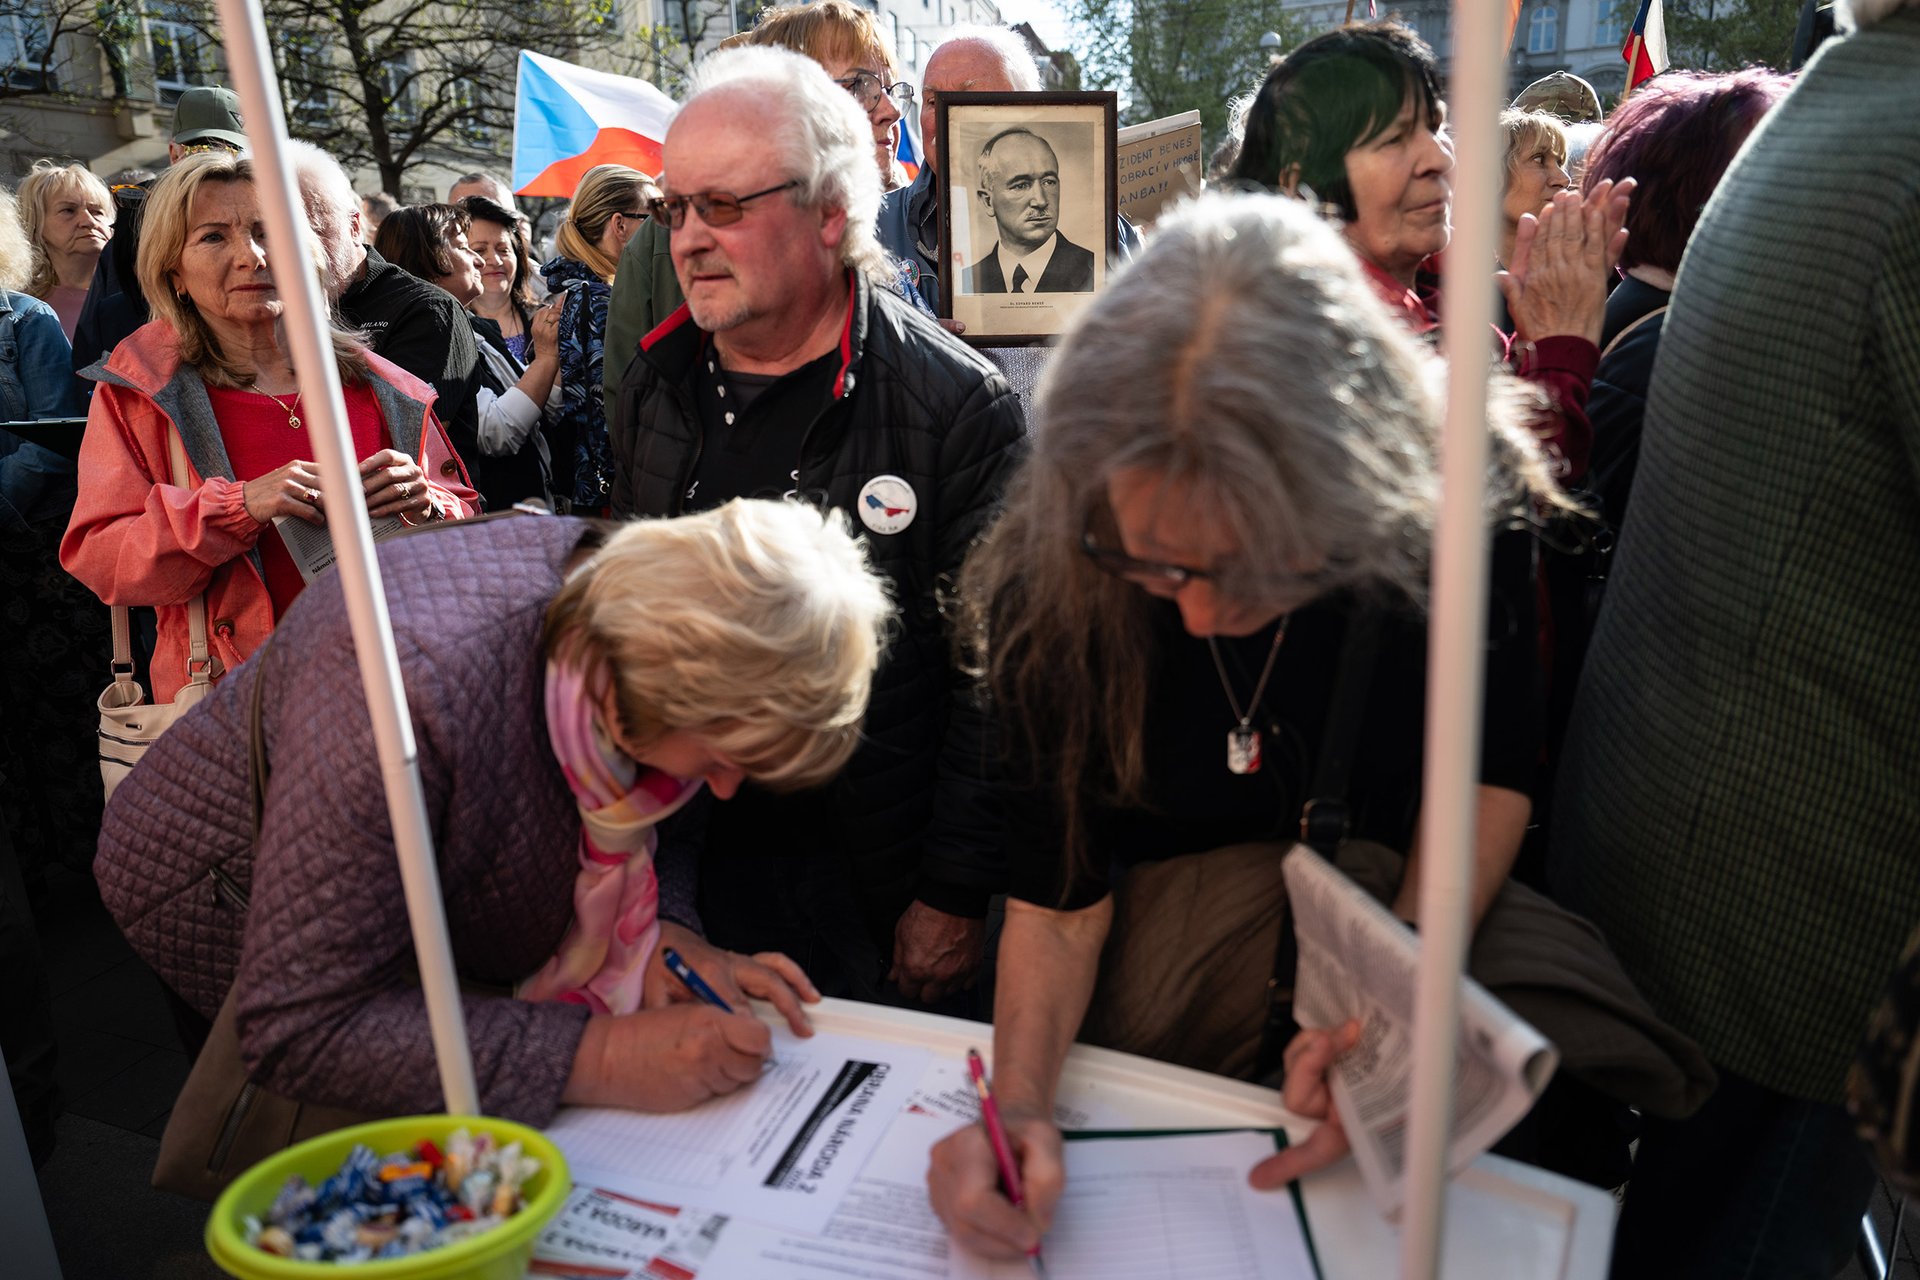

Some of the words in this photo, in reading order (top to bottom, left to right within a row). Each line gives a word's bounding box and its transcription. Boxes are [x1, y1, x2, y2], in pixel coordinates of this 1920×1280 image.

[1119, 148, 1154, 170] ZIDENT
[1159, 134, 1193, 156] BENEŠ
[1120, 160, 1160, 185] OBRACÍ
[1163, 162, 1170, 172] V
[807, 1117, 857, 1180] NÁRODA
